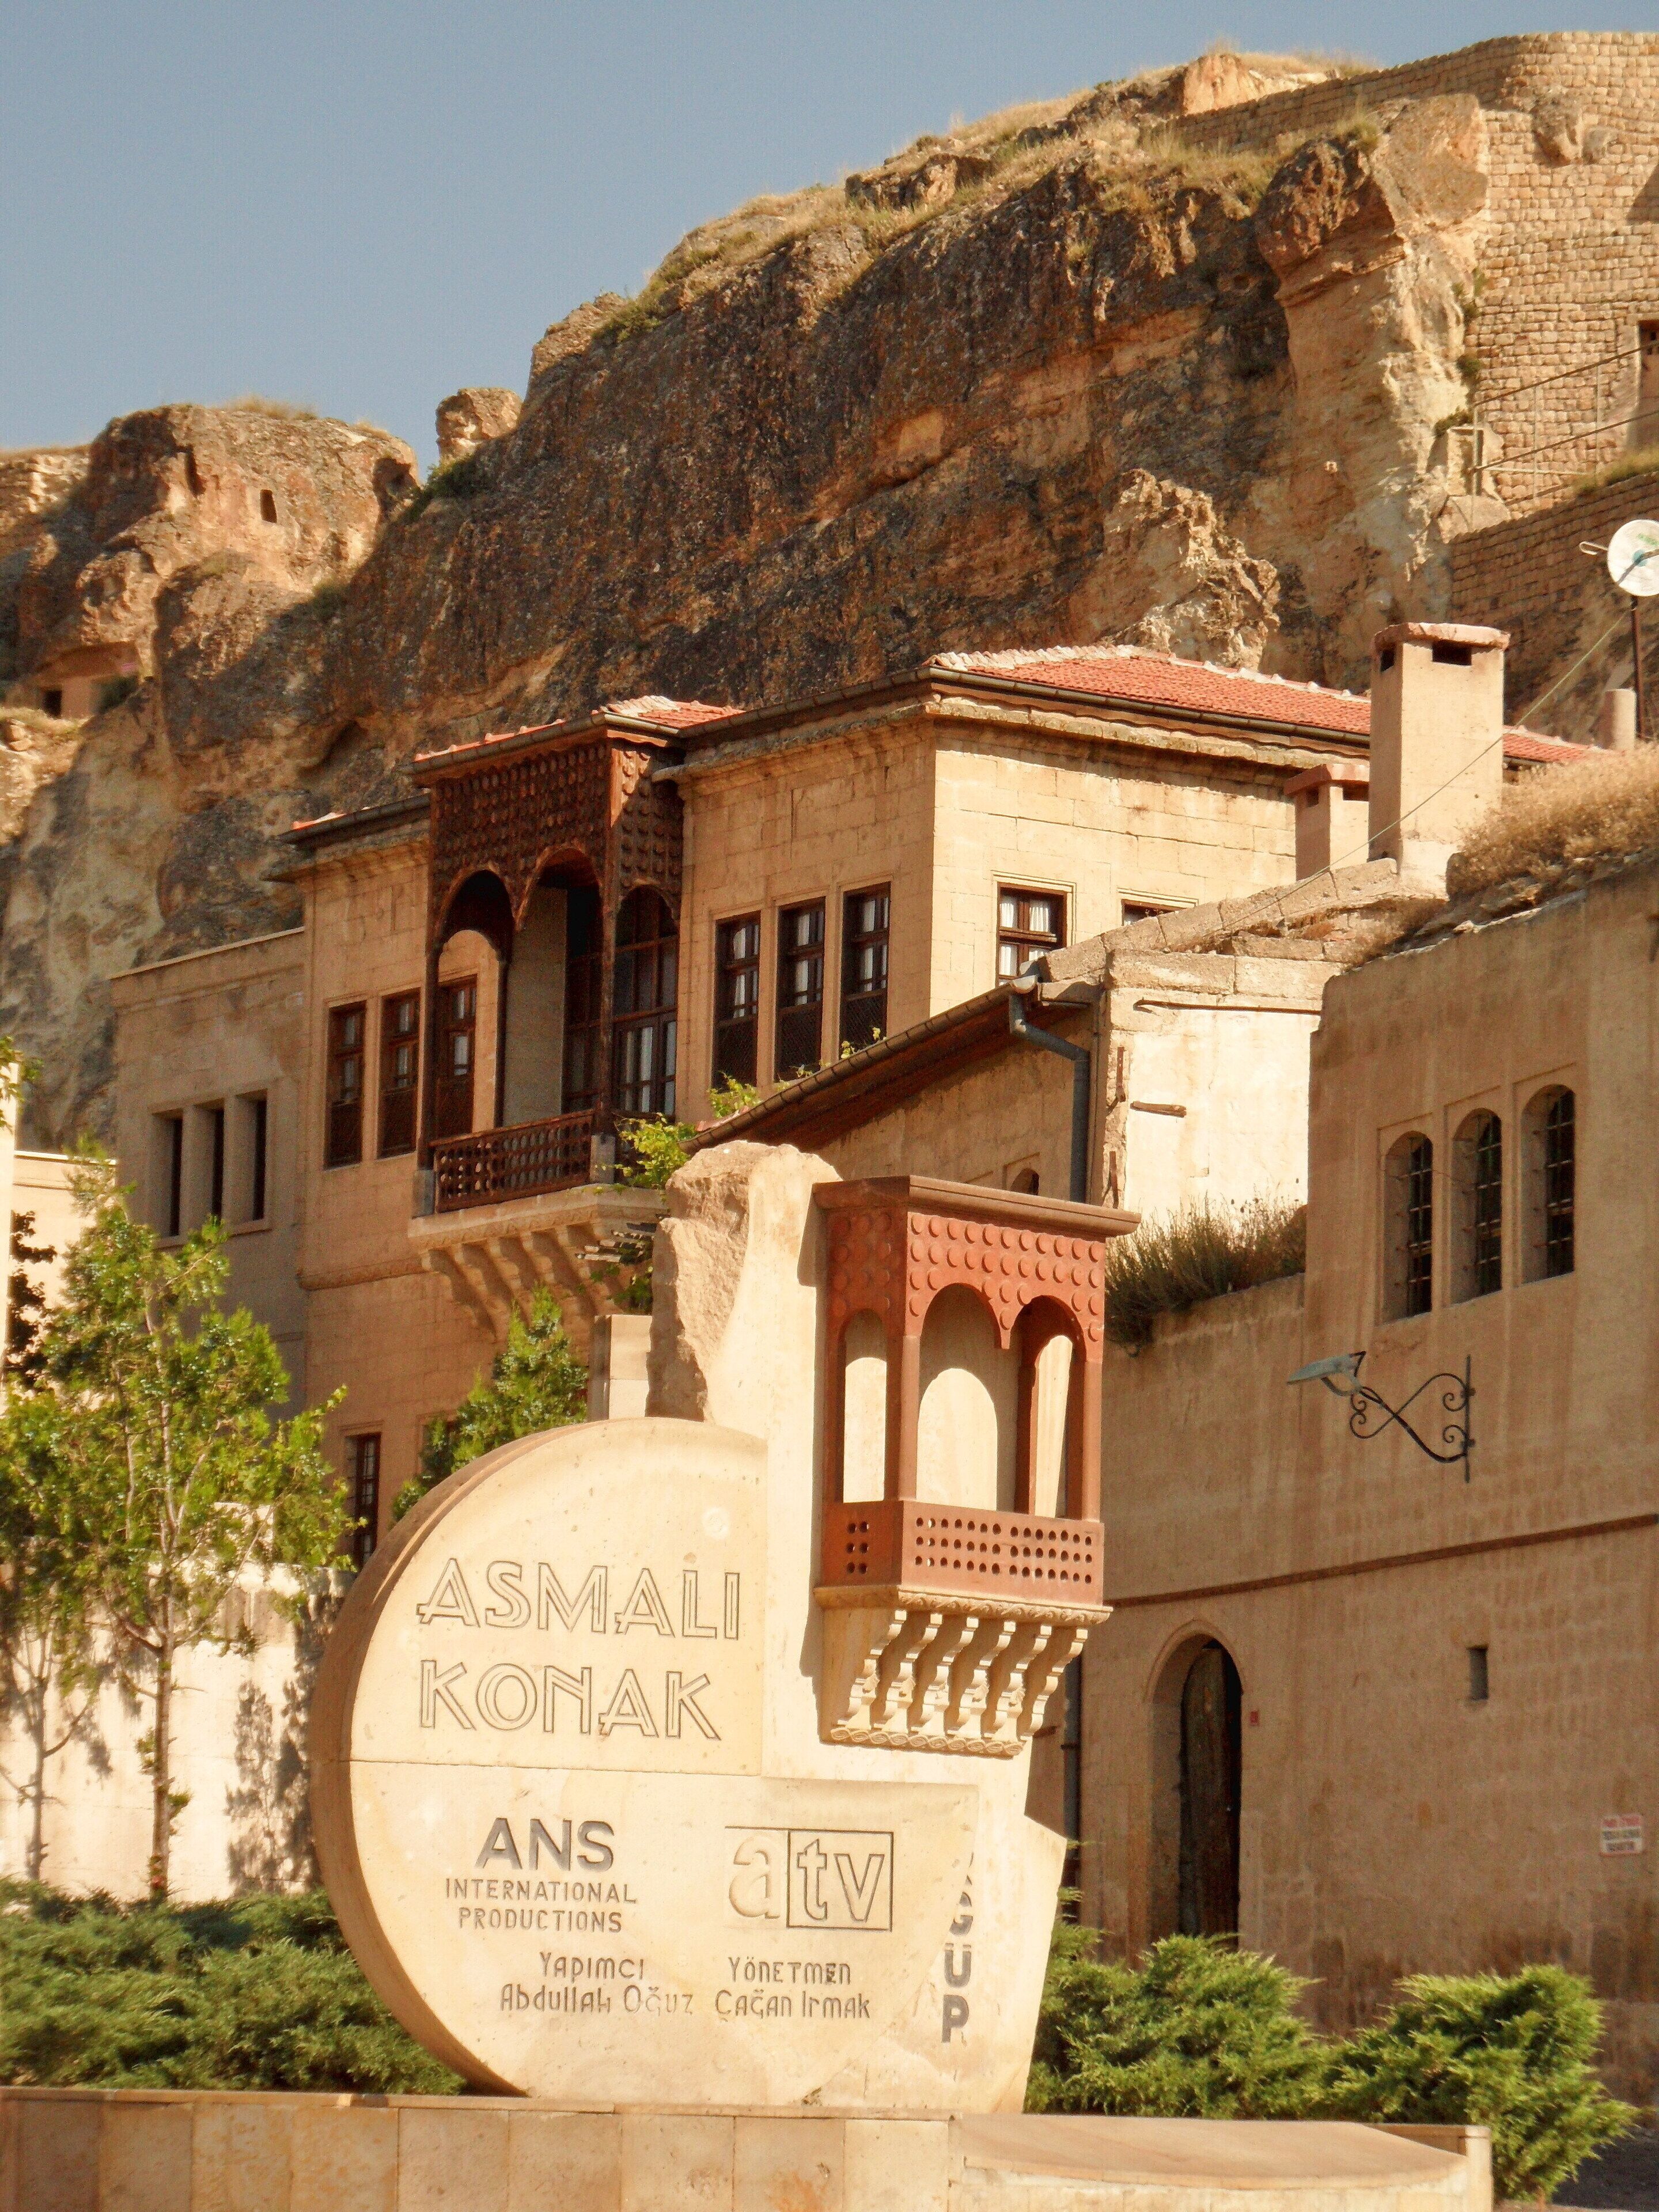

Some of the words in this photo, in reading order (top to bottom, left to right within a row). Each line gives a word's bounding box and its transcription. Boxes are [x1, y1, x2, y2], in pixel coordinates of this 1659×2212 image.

[416, 1558, 740, 1640] ASMALI
[419, 1660, 721, 1741] KONAK
[474, 1817, 615, 1872] ANS
[445, 1878, 638, 1904] INTERNATIONAL
[728, 1834, 885, 1923] atv
[459, 1907, 623, 1933] PRODUCTIONS
[499, 1983, 611, 2014] Abdullah
[623, 1984, 694, 2016] Oğuz
